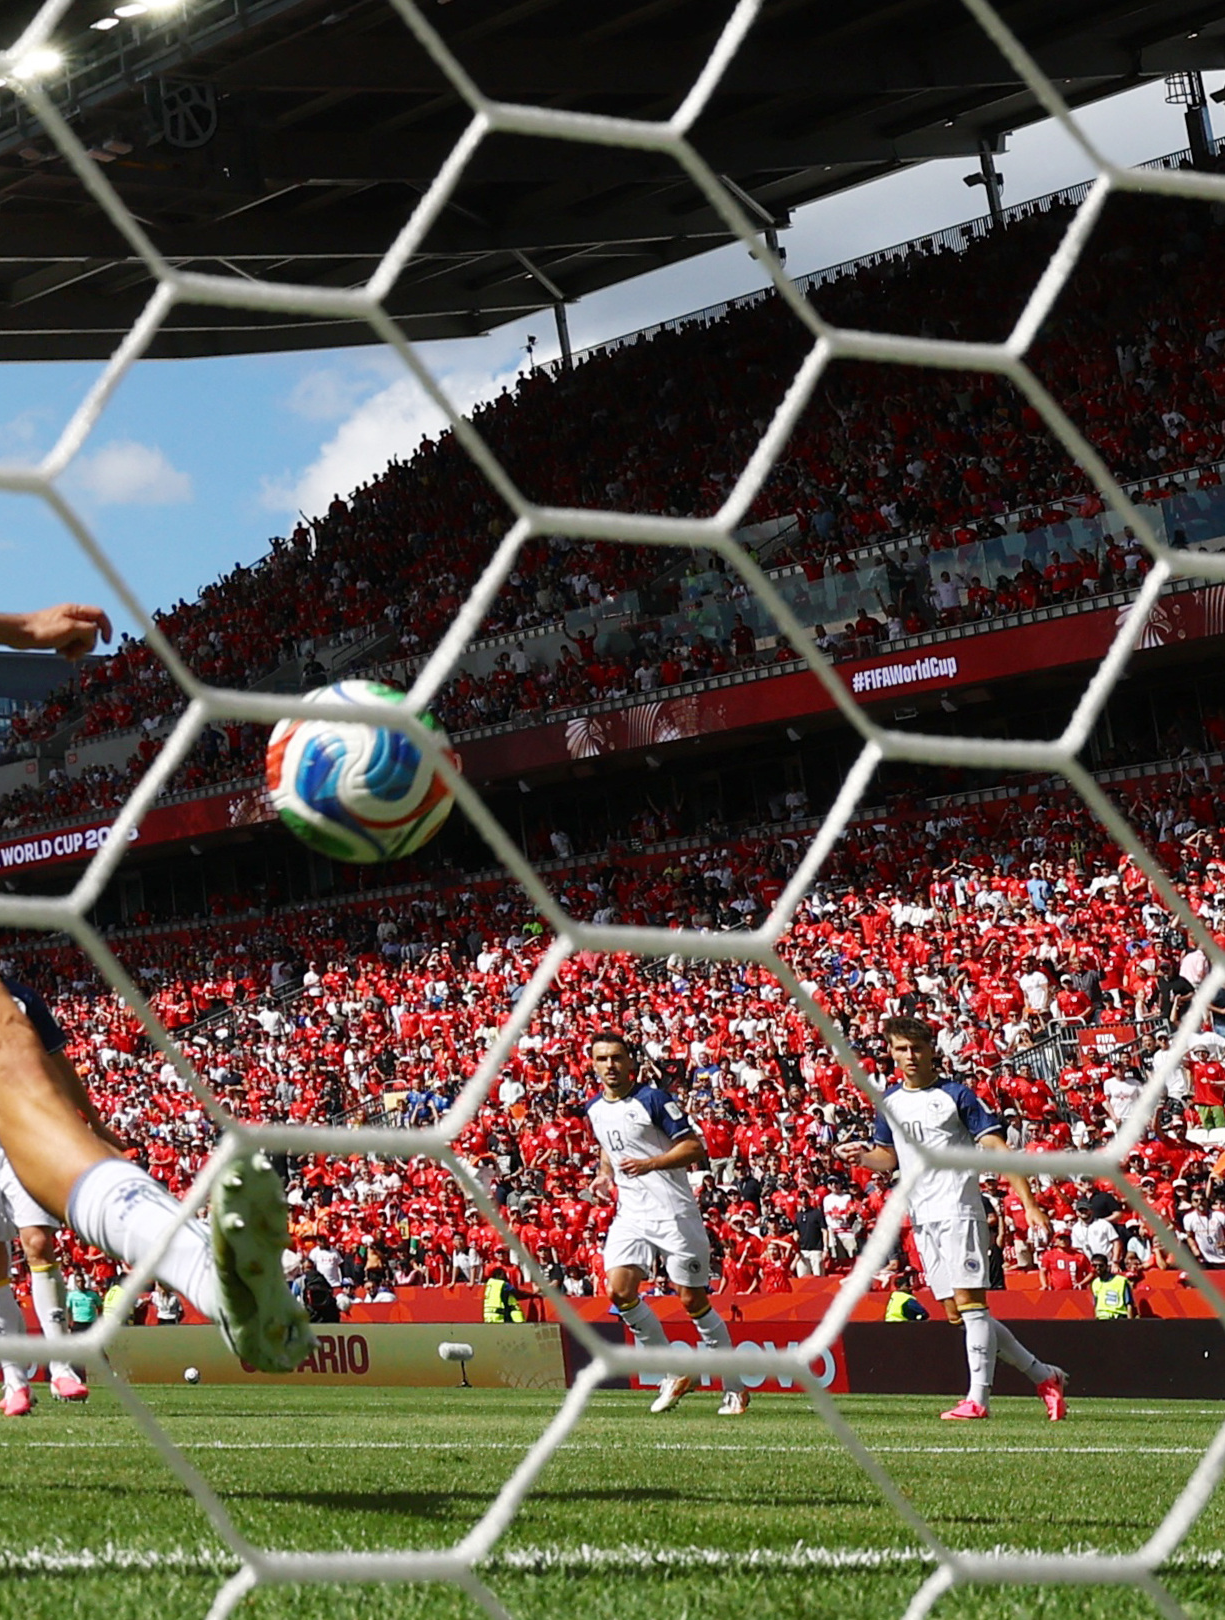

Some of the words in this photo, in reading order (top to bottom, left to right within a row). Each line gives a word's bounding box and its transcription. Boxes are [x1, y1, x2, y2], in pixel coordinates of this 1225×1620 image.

[852, 656, 957, 692] #FIFAWorldCup
[1, 839, 52, 866] WORLD
[54, 832, 83, 855] CUP
[85, 824, 138, 850] 206
[607, 1130, 625, 1151] 13
